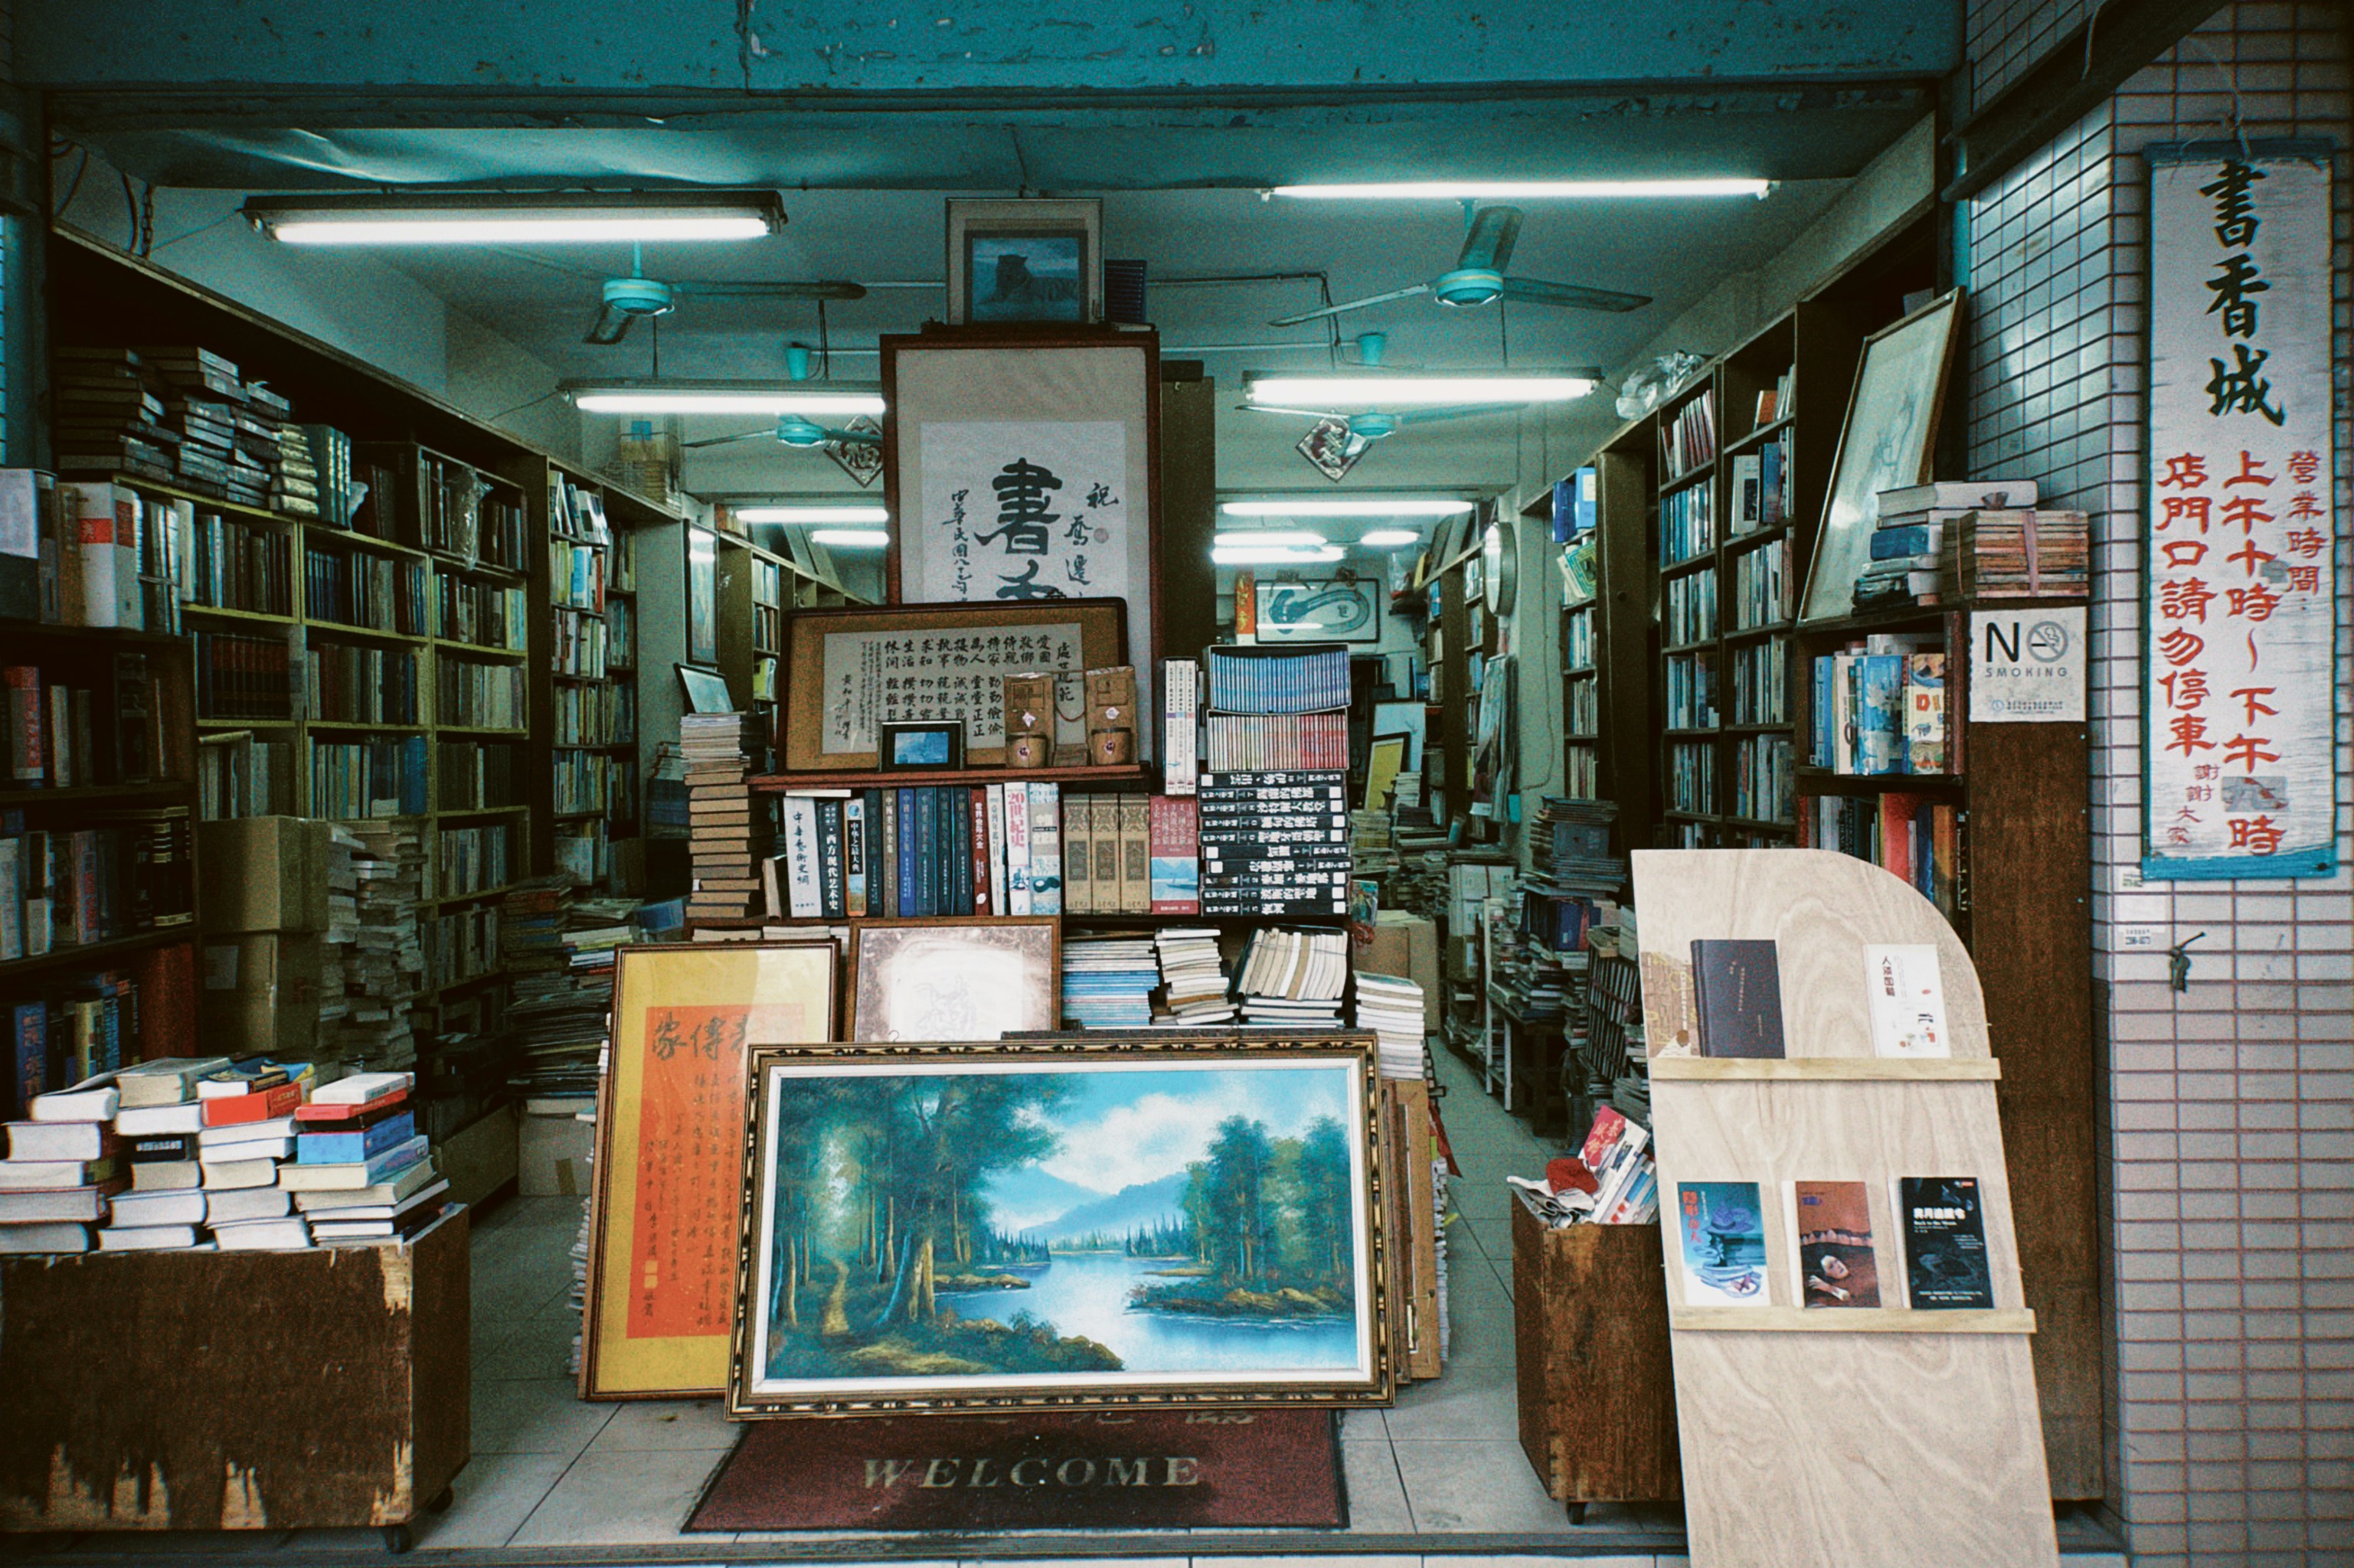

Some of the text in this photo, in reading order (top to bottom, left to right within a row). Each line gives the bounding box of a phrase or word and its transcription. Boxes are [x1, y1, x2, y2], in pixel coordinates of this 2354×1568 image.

[2200, 158, 2285, 426] 書香城
[2156, 452, 2218, 758] 店門口請勿停車
[1985, 667, 2068, 678] SMOKING
[1008, 792, 1025, 848] 20世紀史
[2166, 764, 2219, 845] 謝謝大家
[864, 1458, 1199, 1488] WELCOME
